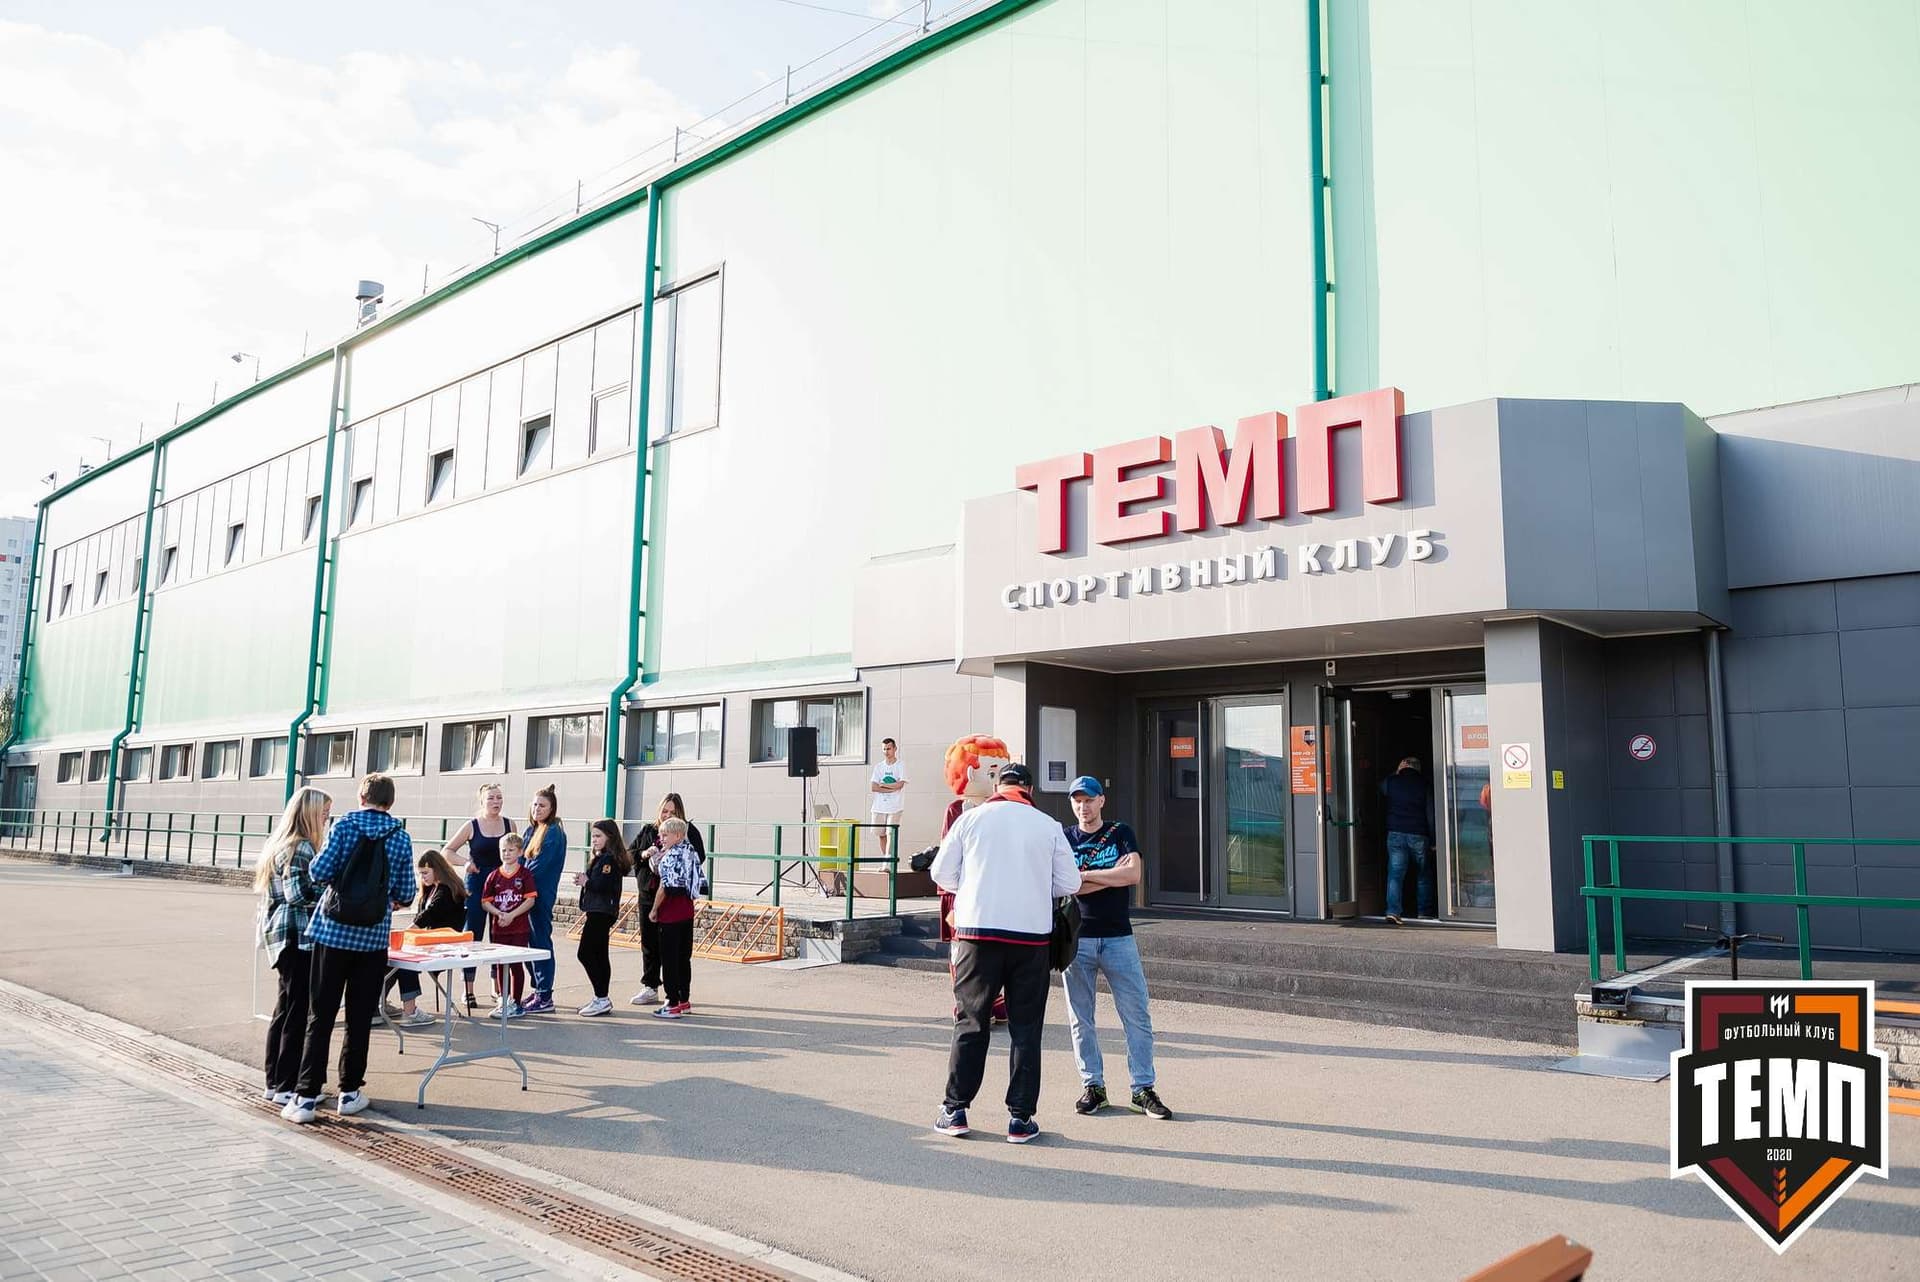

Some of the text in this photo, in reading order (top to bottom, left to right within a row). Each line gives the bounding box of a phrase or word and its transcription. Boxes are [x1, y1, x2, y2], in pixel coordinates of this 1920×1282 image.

[1016, 387, 1405, 554] ТЕМП
[1001, 529, 1435, 609] СПОРТИВНЫЙ КЛУБ
